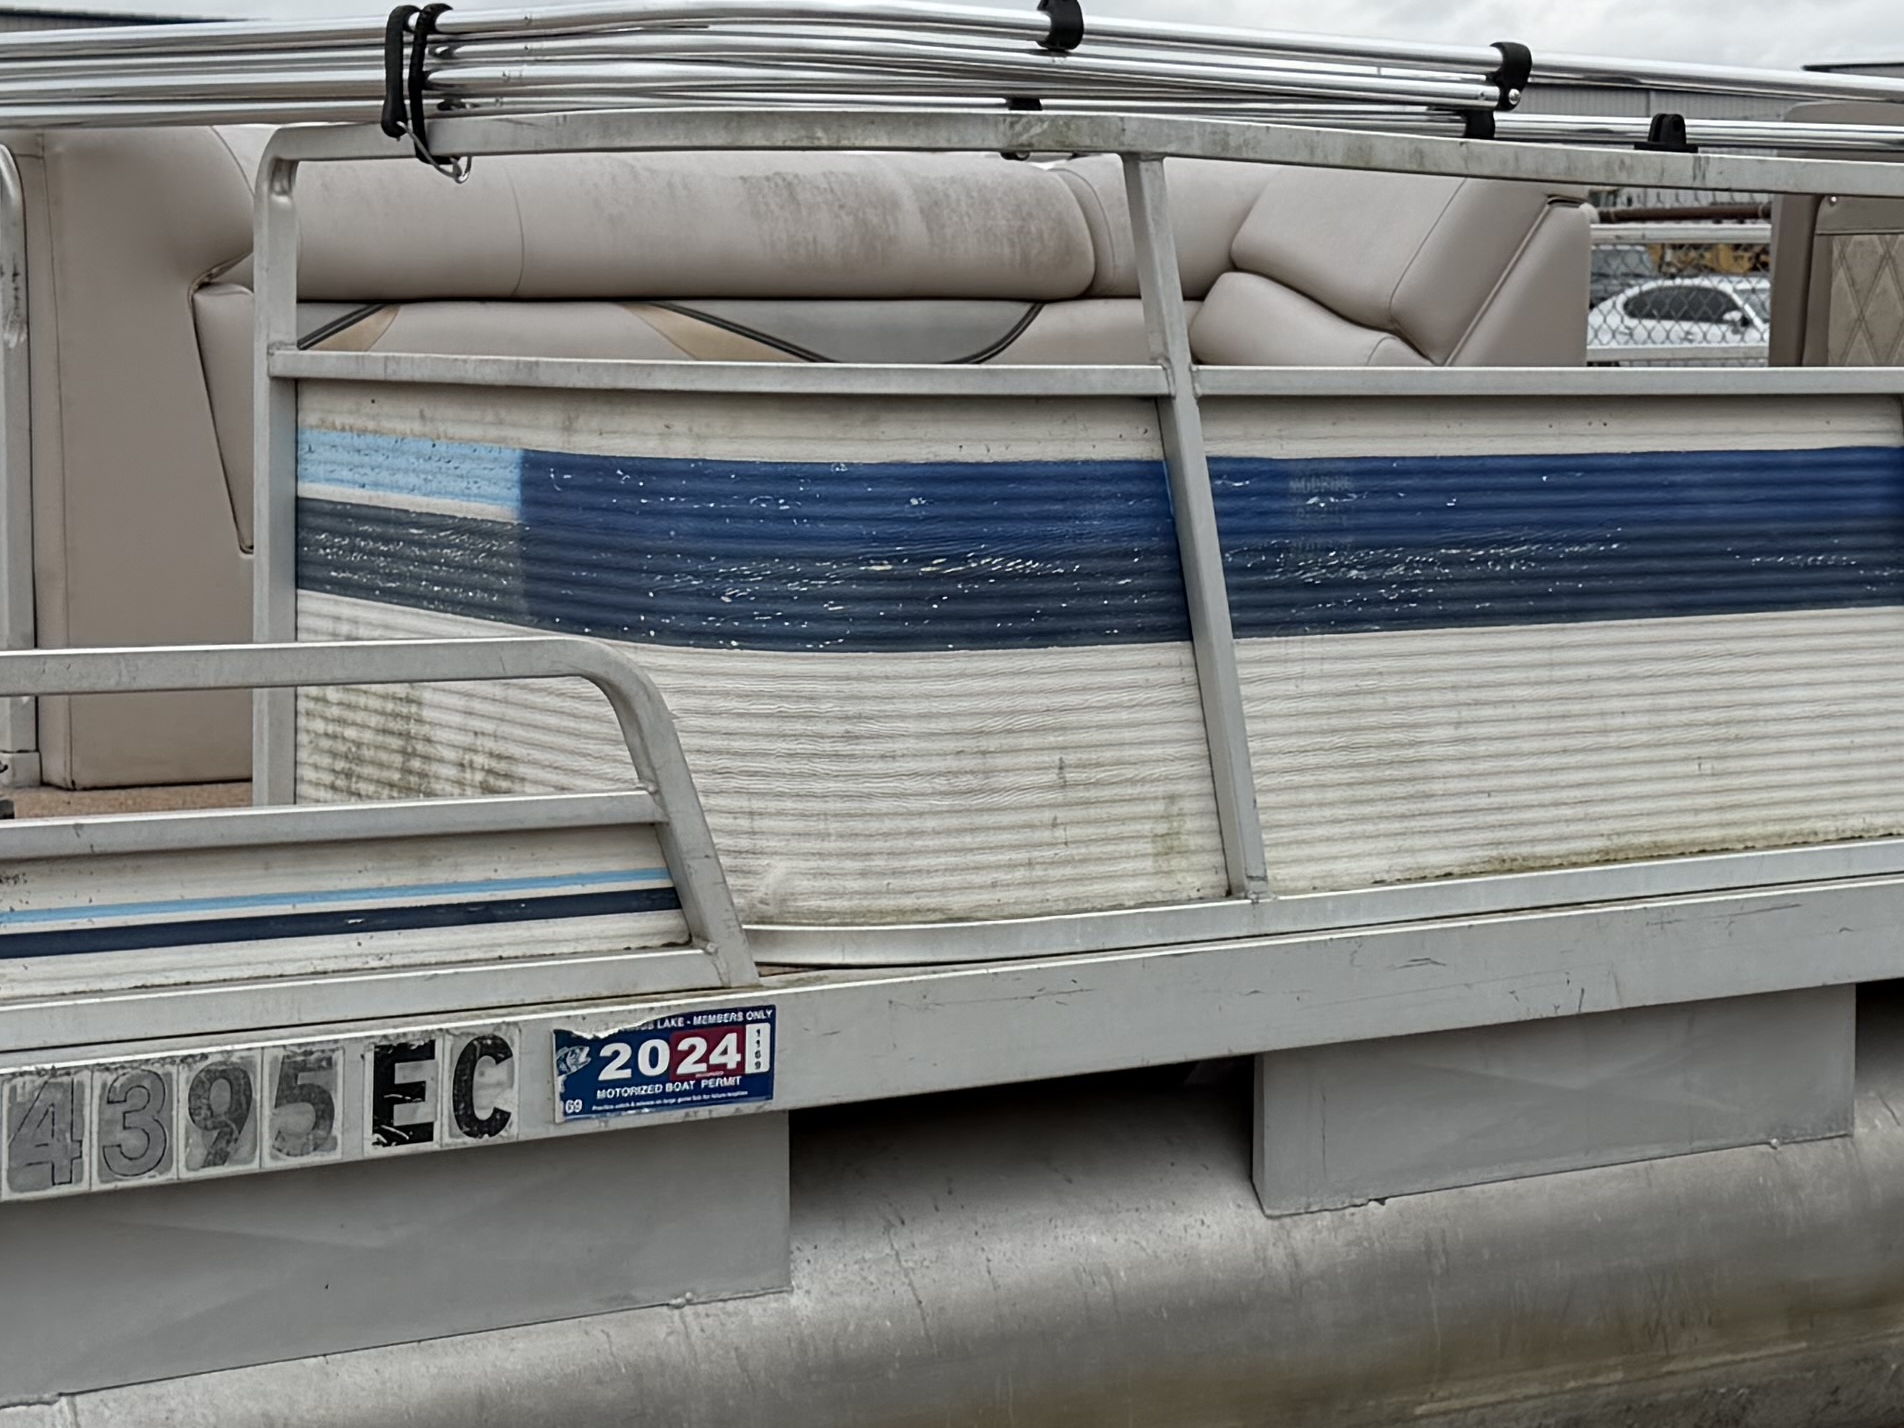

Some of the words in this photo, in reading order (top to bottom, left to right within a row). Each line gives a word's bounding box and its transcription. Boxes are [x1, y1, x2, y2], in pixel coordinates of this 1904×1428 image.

[657, 1017, 685, 1029] LAKE
[693, 1011, 744, 1026] MEMBERS
[746, 1009, 772, 1021] ONLY
[598, 1032, 742, 1081] 2024
[596, 1083, 663, 1100] MOTORIZED
[665, 1080, 696, 1093] BOAT
[700, 1076, 743, 1089] PERMIT
[9, 1050, 335, 1186] 4395
[371, 1034, 515, 1147] EC
